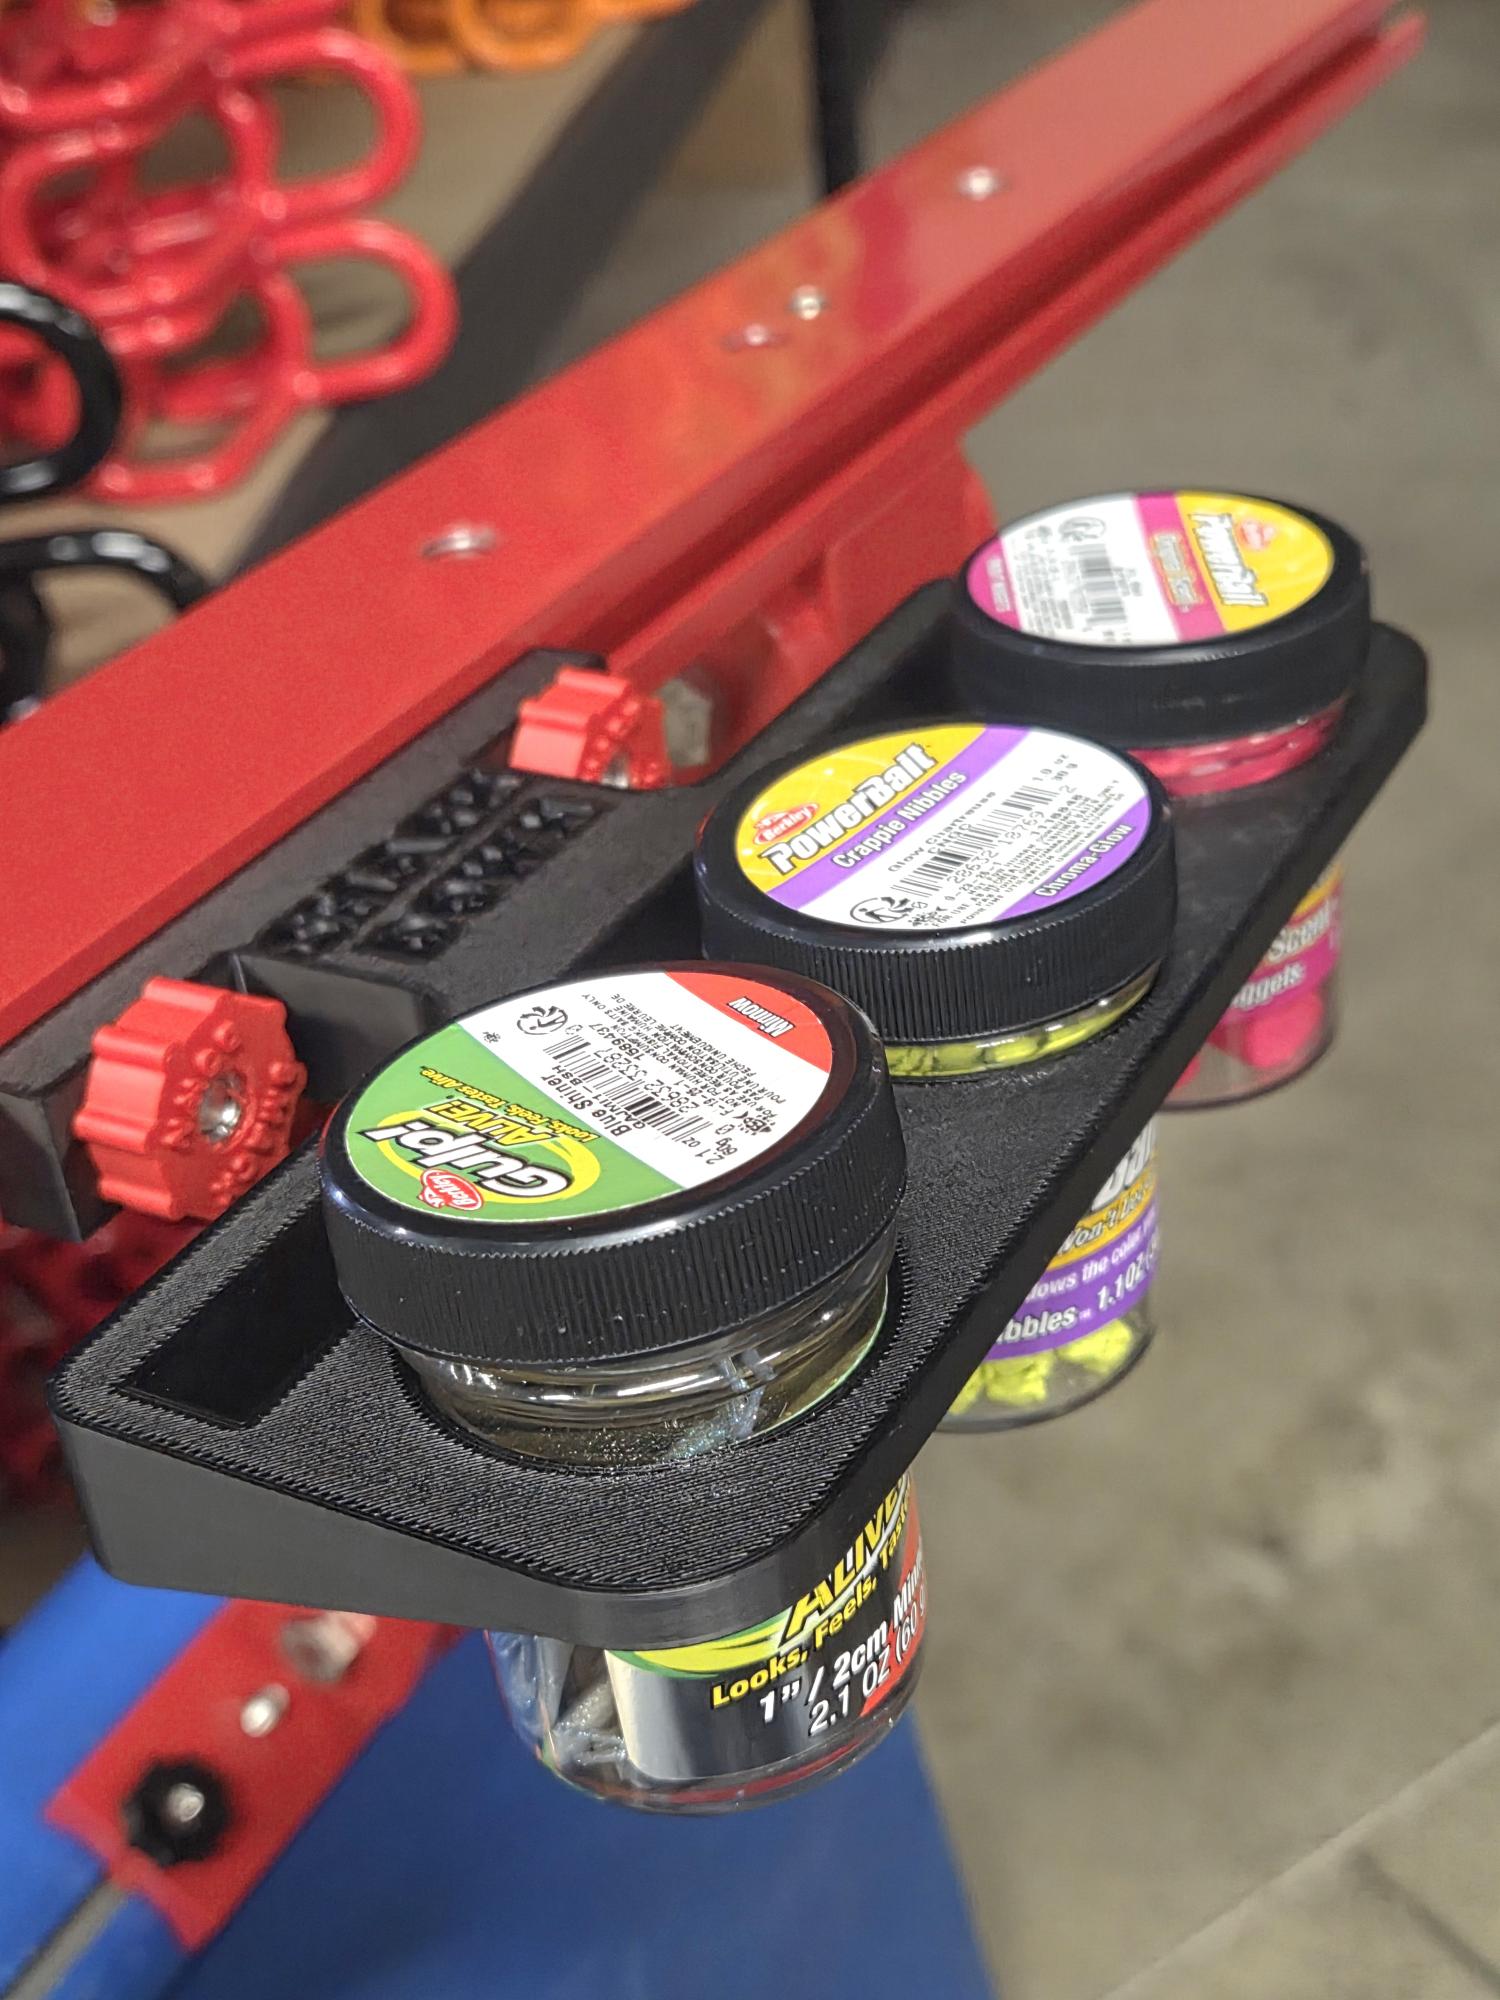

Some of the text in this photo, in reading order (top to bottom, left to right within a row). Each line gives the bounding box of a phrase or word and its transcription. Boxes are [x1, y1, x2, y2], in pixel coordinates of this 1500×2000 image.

[756, 742, 939, 875] PowerBait
[829, 771, 969, 868] Crappie Nibbles
[944, 849, 999, 883] 28632
[1032, 824, 1134, 895] Chroma-Glow
[580, 992, 607, 1009] ONLY
[726, 996, 795, 1038] Minnow
[592, 1045, 649, 1081] 33287
[667, 1063, 702, 1085] HUMAN
[456, 1085, 508, 1108] Tastes
[641, 1078, 699, 1114] 28632
[699, 1083, 721, 1095] FOR
[718, 1094, 741, 1107] NOT
[721, 1086, 738, 1096] AS
[735, 1094, 758, 1107] USE
[741, 1088, 764, 1100] PAS
[504, 1103, 551, 1125] Feels,
[538, 1072, 632, 1136] Blue Shiner
[546, 1119, 601, 1142] Looks,
[356, 1119, 572, 1196] Gulp!
[680, 1136, 725, 1165] 2.1 oz
[427, 1175, 480, 1204] Berkley
[1082, 1256, 1109, 1282] the
[711, 1647, 809, 1709] Looks,
[813, 1575, 878, 1650] Feels,
[833, 1620, 888, 1688] 2cm
[810, 1685, 850, 1735] 2.1
